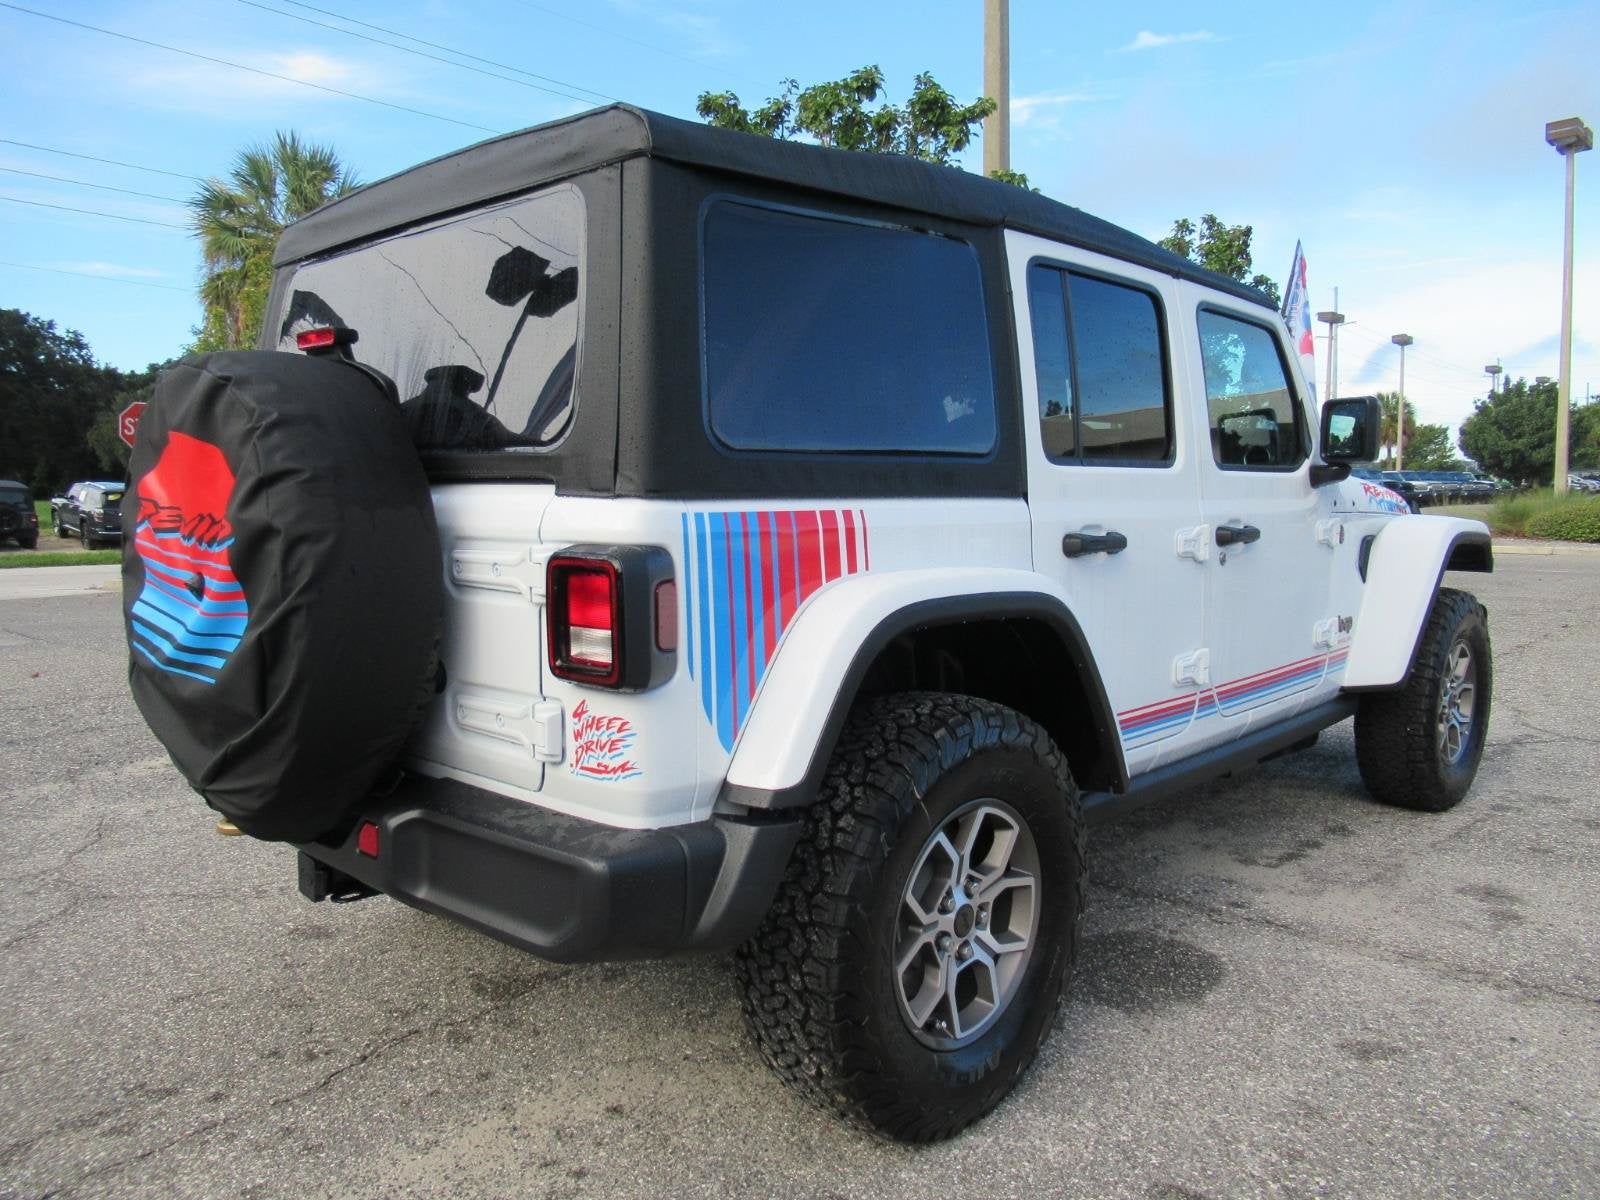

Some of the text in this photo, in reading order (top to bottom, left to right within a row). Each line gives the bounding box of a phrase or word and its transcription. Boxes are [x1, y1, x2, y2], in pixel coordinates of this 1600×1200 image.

[572, 699, 589, 721] 4
[573, 715, 632, 742] WHEEL
[575, 738, 627, 769] DRIVE
